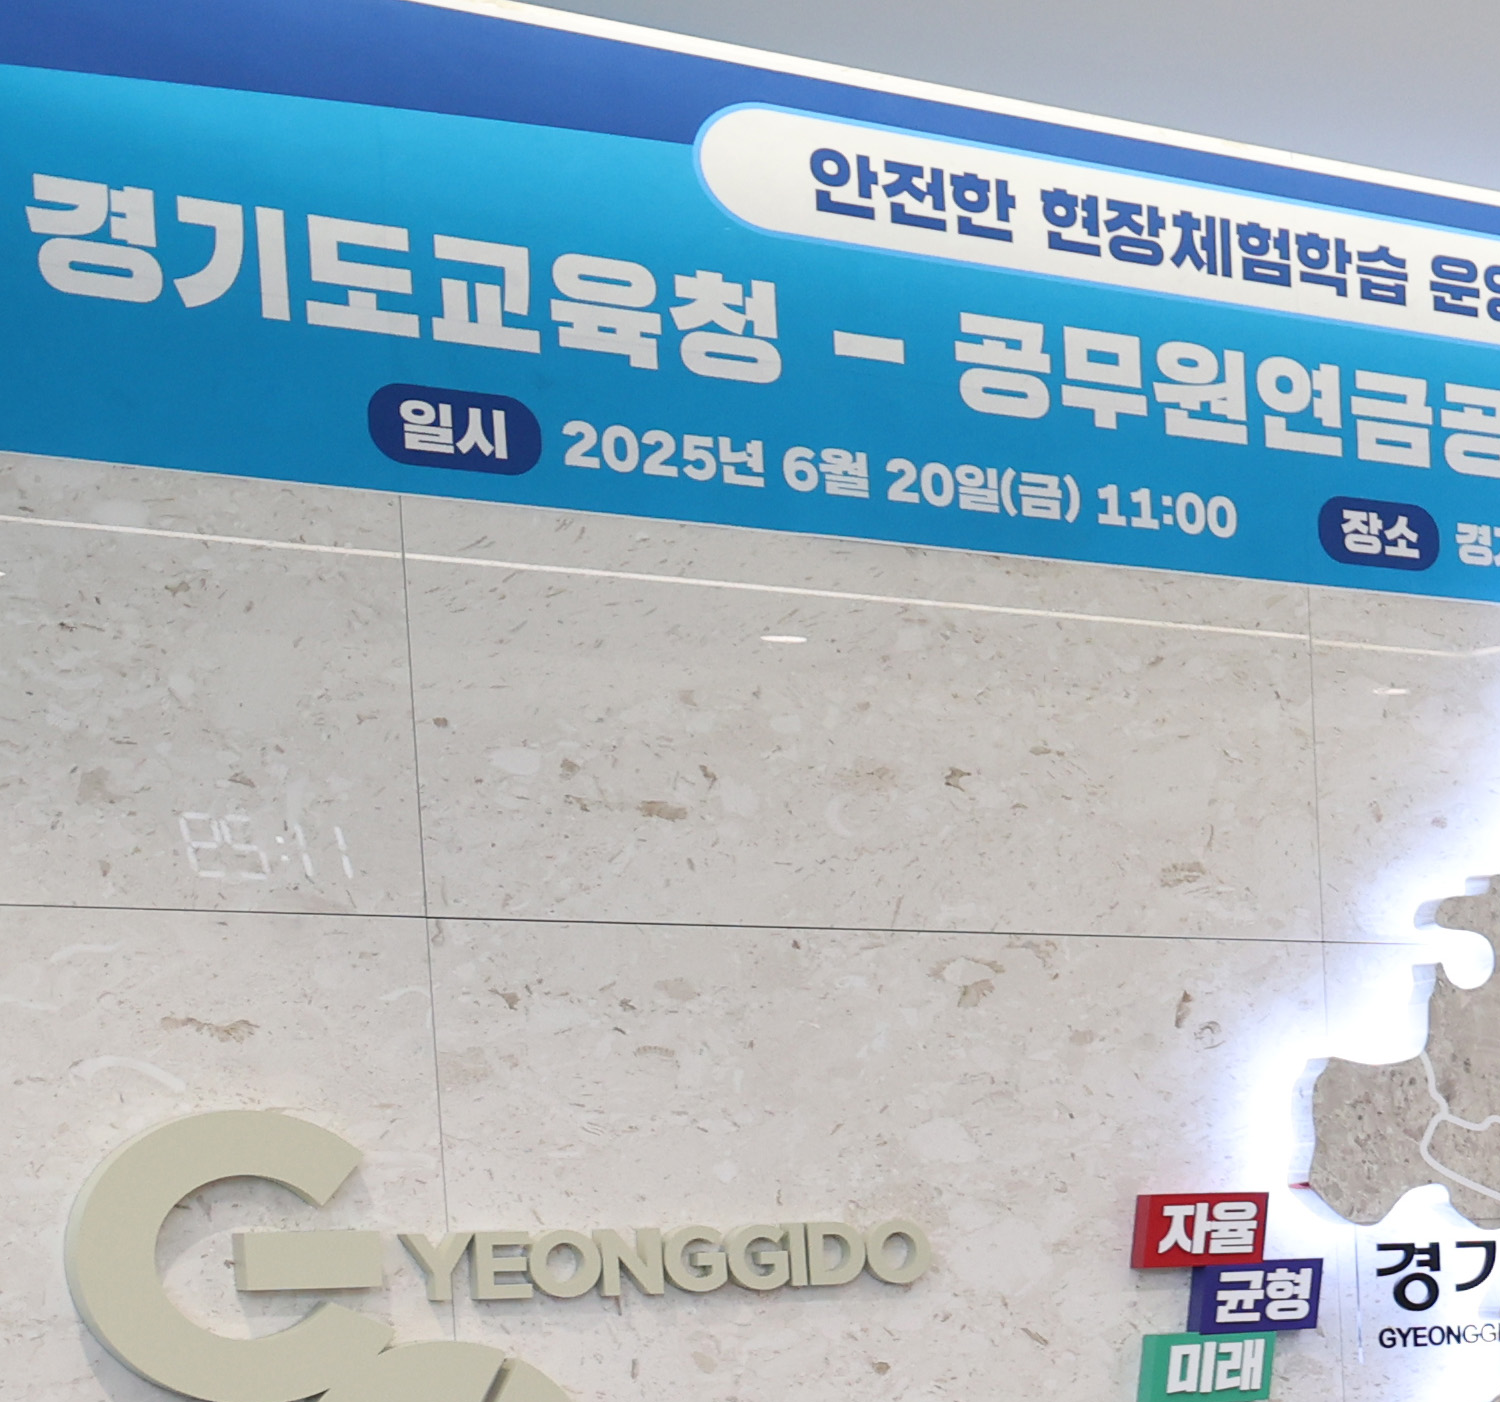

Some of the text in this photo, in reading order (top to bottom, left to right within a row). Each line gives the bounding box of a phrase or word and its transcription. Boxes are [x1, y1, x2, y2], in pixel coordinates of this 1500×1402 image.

[809, 147, 1016, 240] 안전한
[1046, 187, 1408, 305] 현장체험학습
[26, 172, 783, 385] 경기도교육청
[400, 400, 508, 459] 일시
[563, 421, 1237, 539] 2025년 6월 20일(금) 11:00
[1341, 508, 1421, 559] 장소
[1158, 1201, 1259, 1255] 자율
[400, 1218, 931, 1302] YEONGGIDO
[1215, 1267, 1313, 1322] 균형
[1166, 1337, 1267, 1395] 미래
